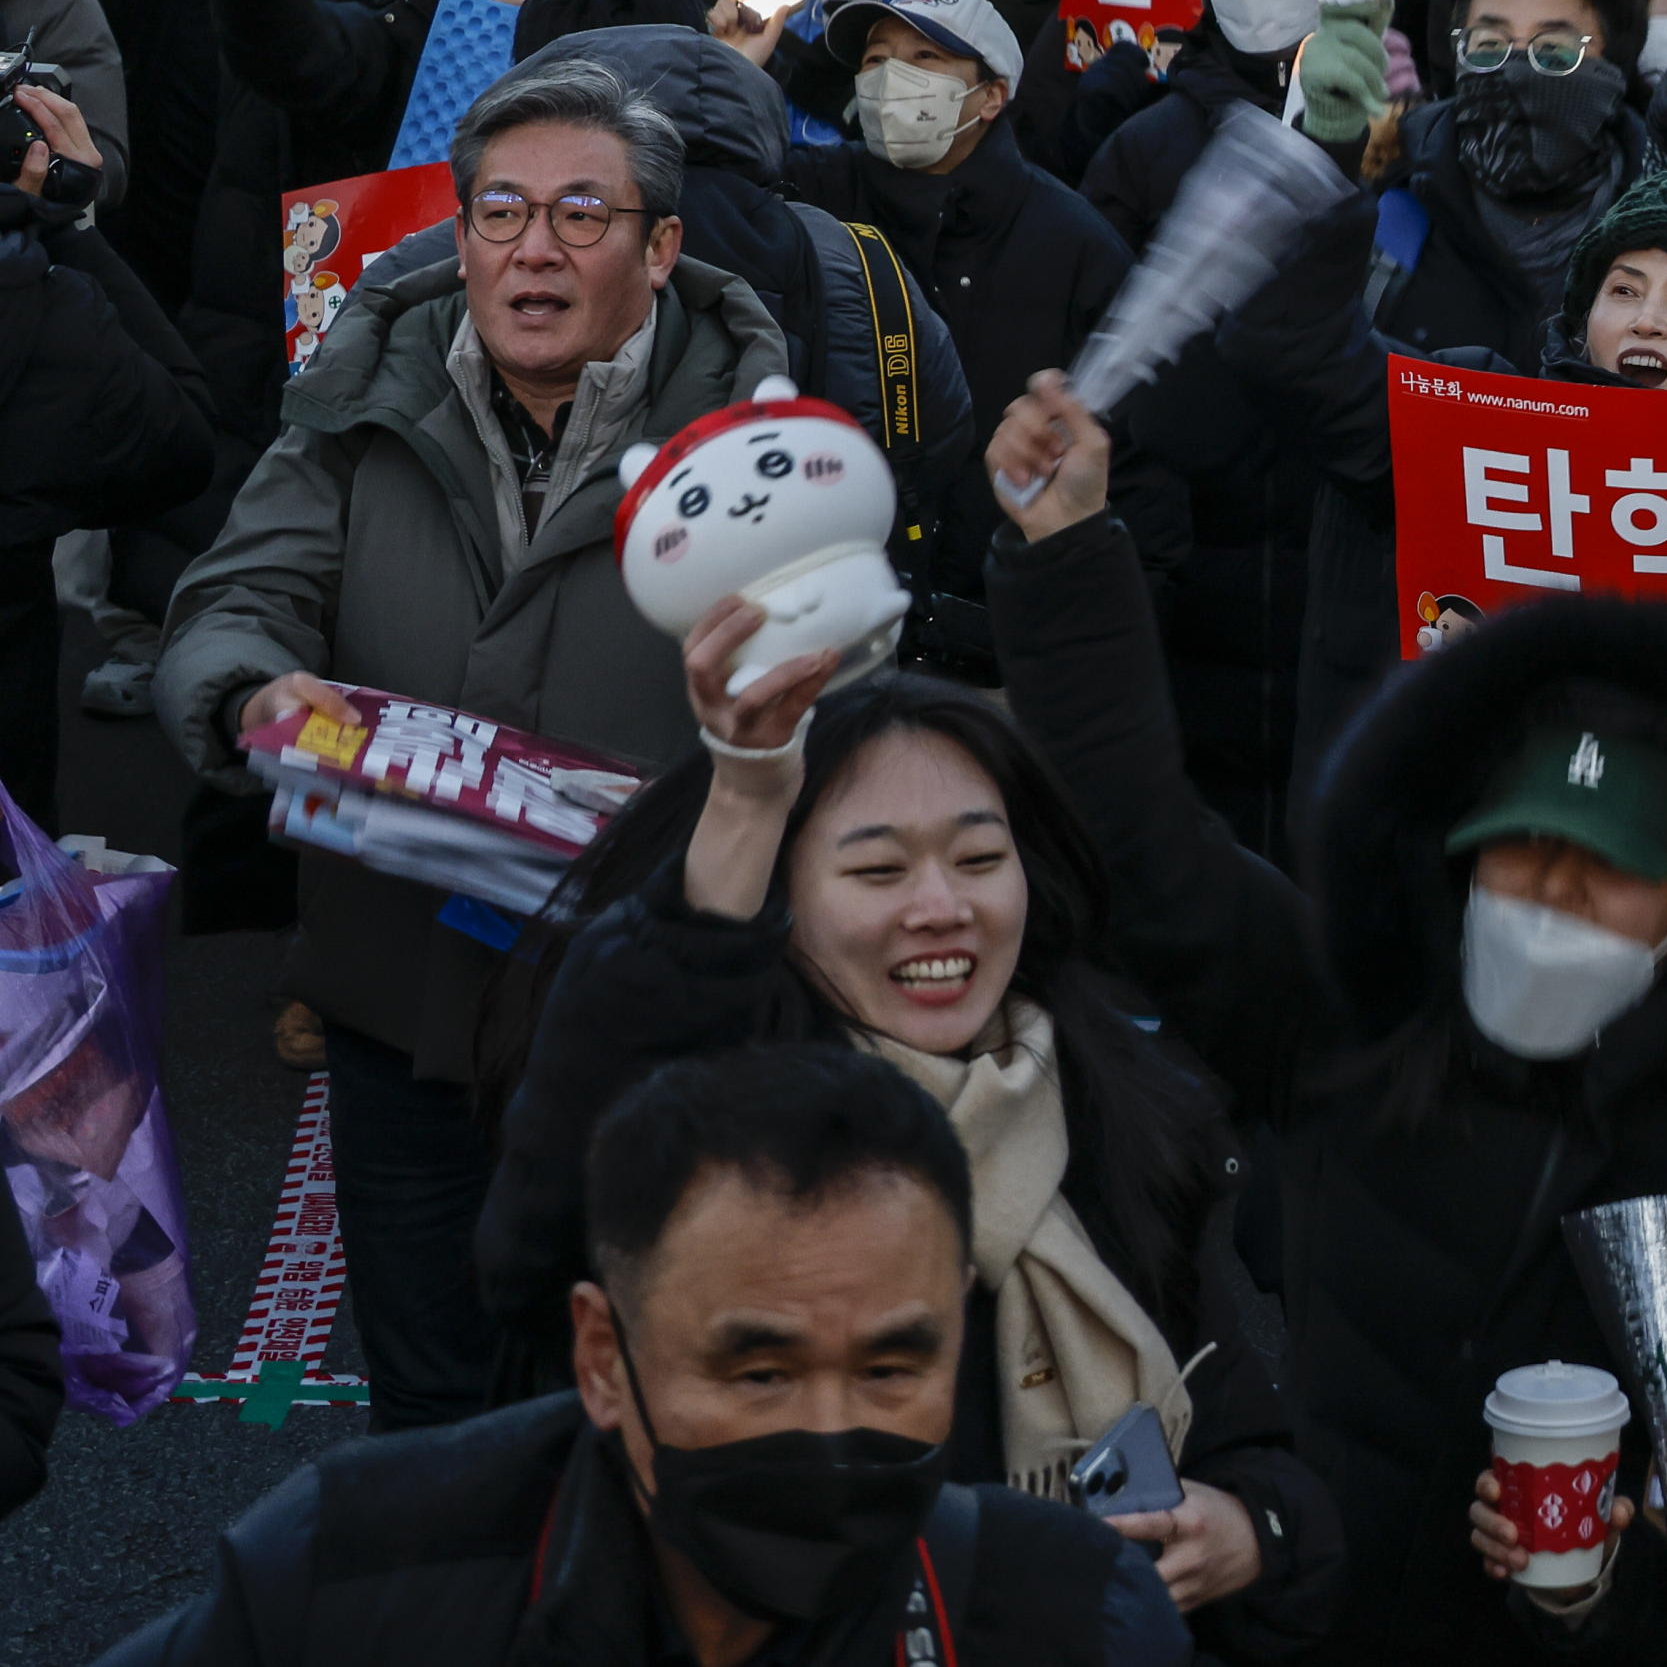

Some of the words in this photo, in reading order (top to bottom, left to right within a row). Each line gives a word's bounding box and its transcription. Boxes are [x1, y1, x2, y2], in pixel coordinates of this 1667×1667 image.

[885, 333, 909, 378] D6
[894, 384, 909, 435] Nikon
[1399, 371, 1463, 400] 나눔문화
[1466, 391, 1589, 420] www.nanum.com
[295, 1192, 338, 1237] DANGER!
[260, 1317, 309, 1362] 안전제일
